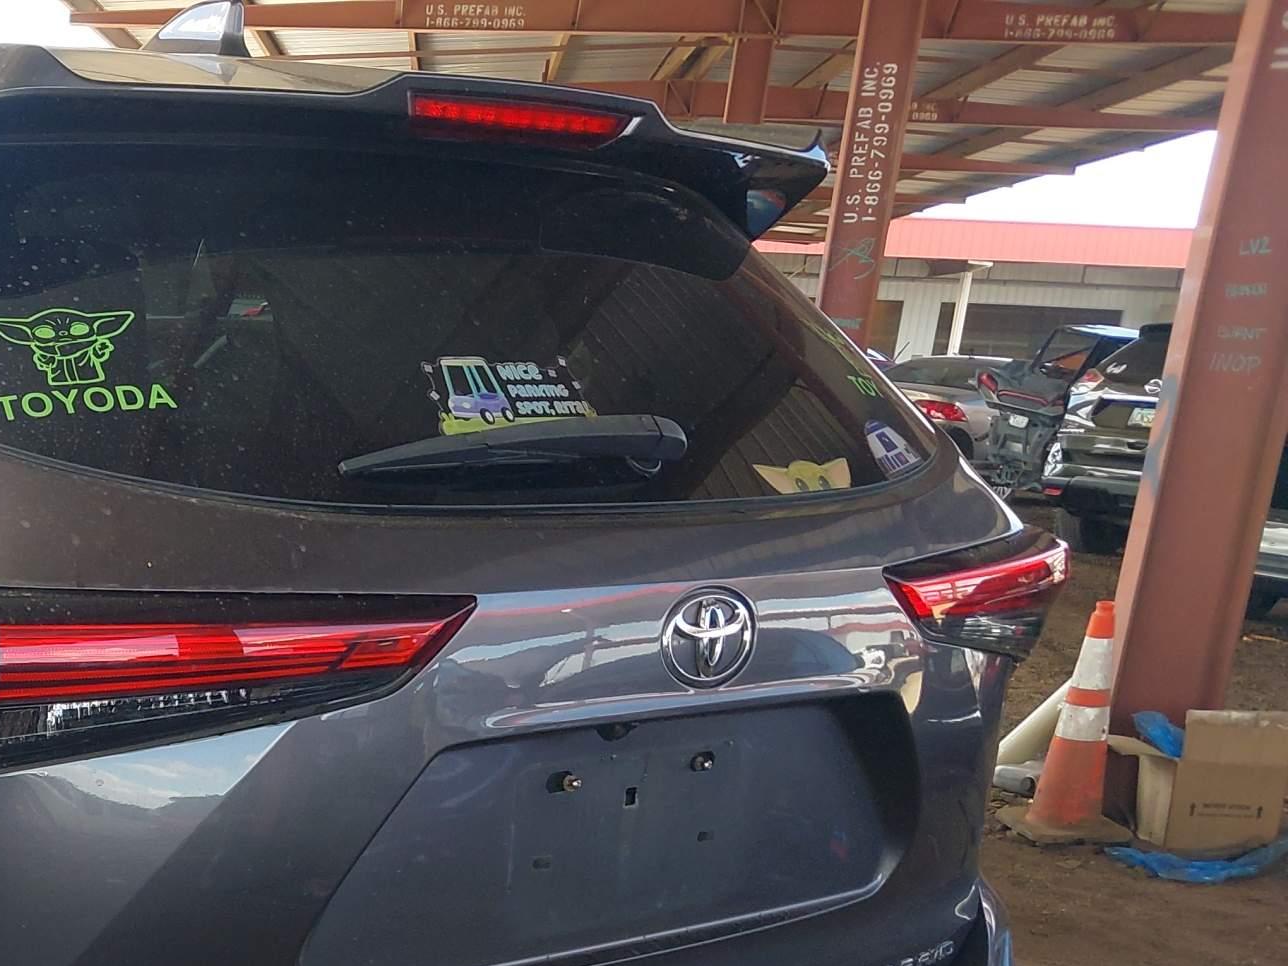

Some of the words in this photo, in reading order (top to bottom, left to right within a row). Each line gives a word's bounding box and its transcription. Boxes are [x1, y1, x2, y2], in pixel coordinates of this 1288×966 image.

[454, 4, 499, 16] PREFAB
[504, 6, 527, 17] INC.
[1036, 14, 1088, 27] PREFAB
[861, 61, 881, 97] INC.
[850, 107, 873, 178] PREFAB
[862, 63, 898, 222] 1-866-799-0969
[843, 190, 863, 223] U.S.
